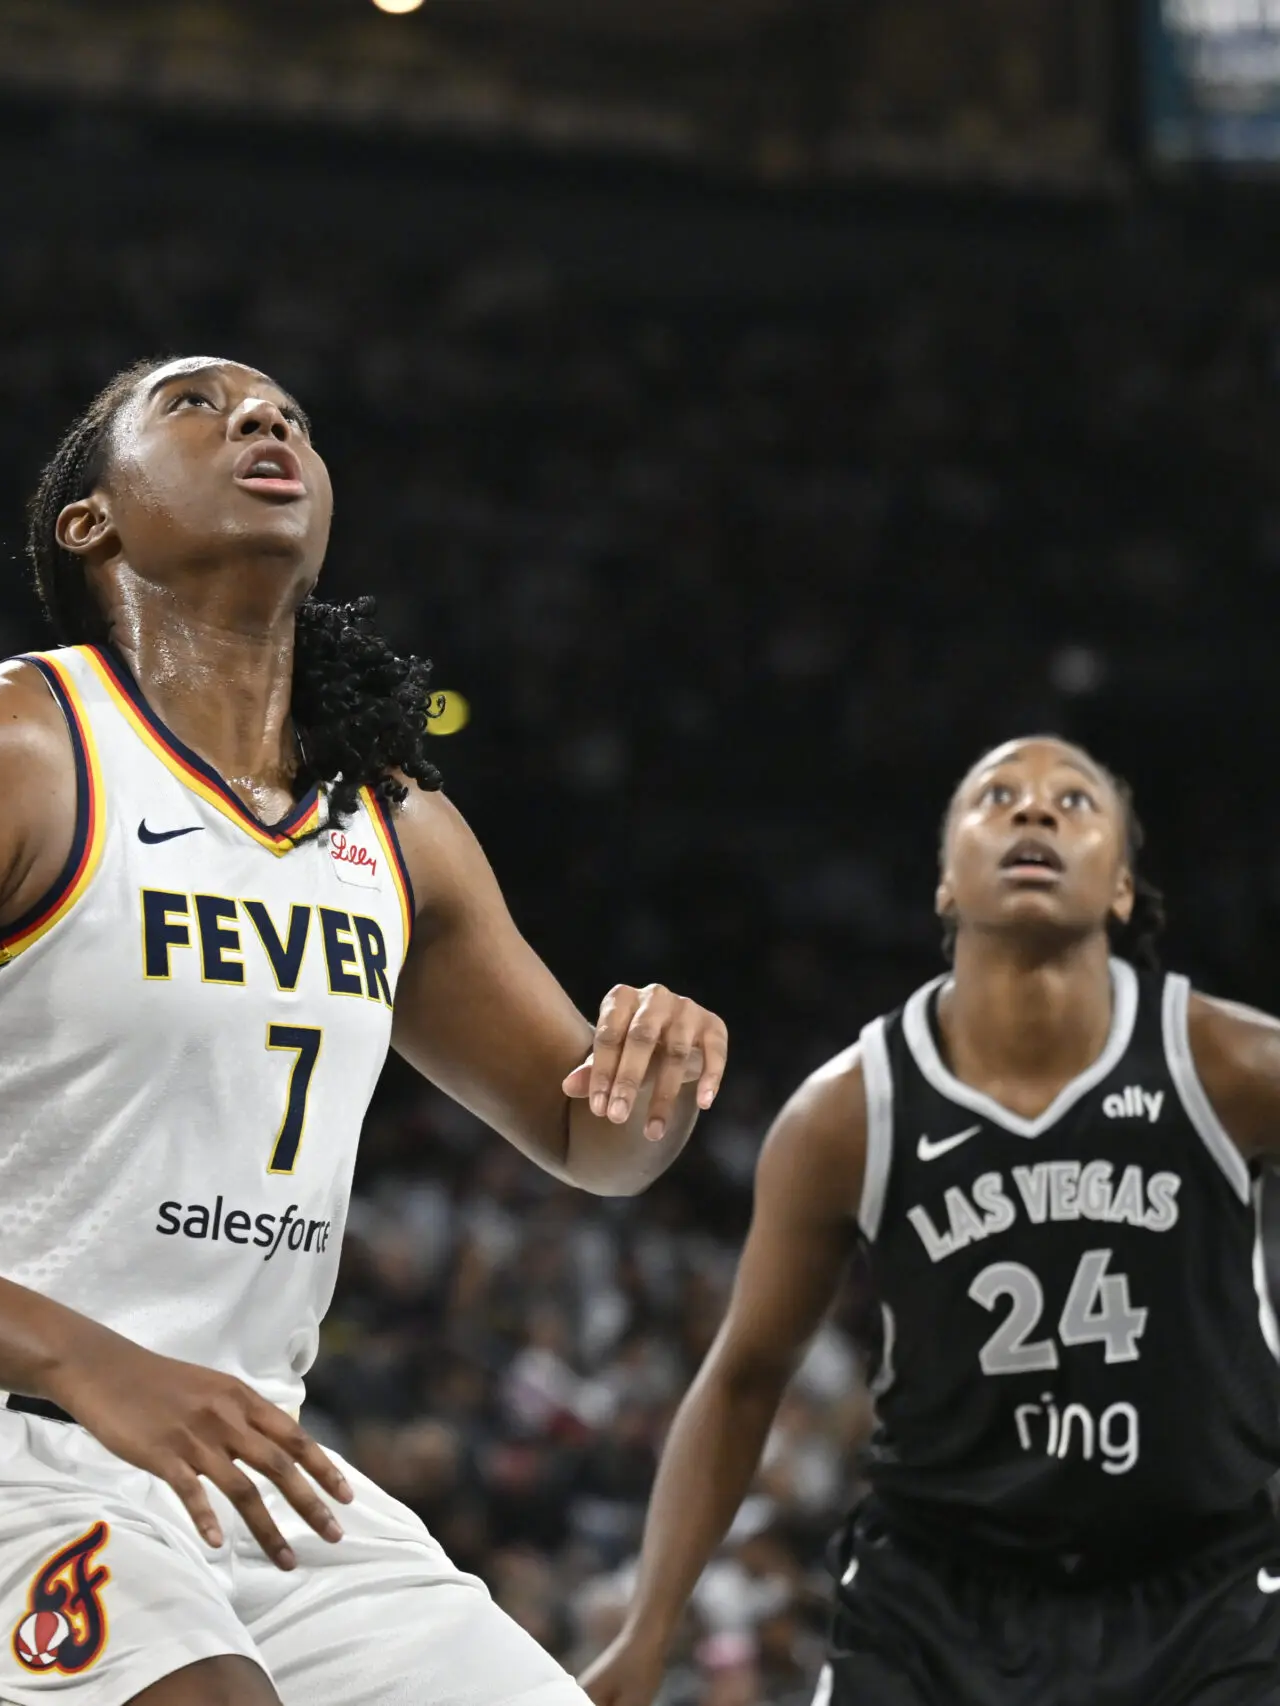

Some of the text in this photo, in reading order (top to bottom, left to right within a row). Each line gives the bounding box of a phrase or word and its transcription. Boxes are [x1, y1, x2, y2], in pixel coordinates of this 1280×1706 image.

[330, 831, 377, 877] Lilly
[140, 887, 394, 1011] FEVER
[266, 1022, 323, 1175] 7
[1102, 1085, 1164, 1123] ally
[906, 1160, 1182, 1263] LAS VEGAS
[968, 1248, 1148, 1375] 24
[1014, 1392, 1140, 1475] ring
